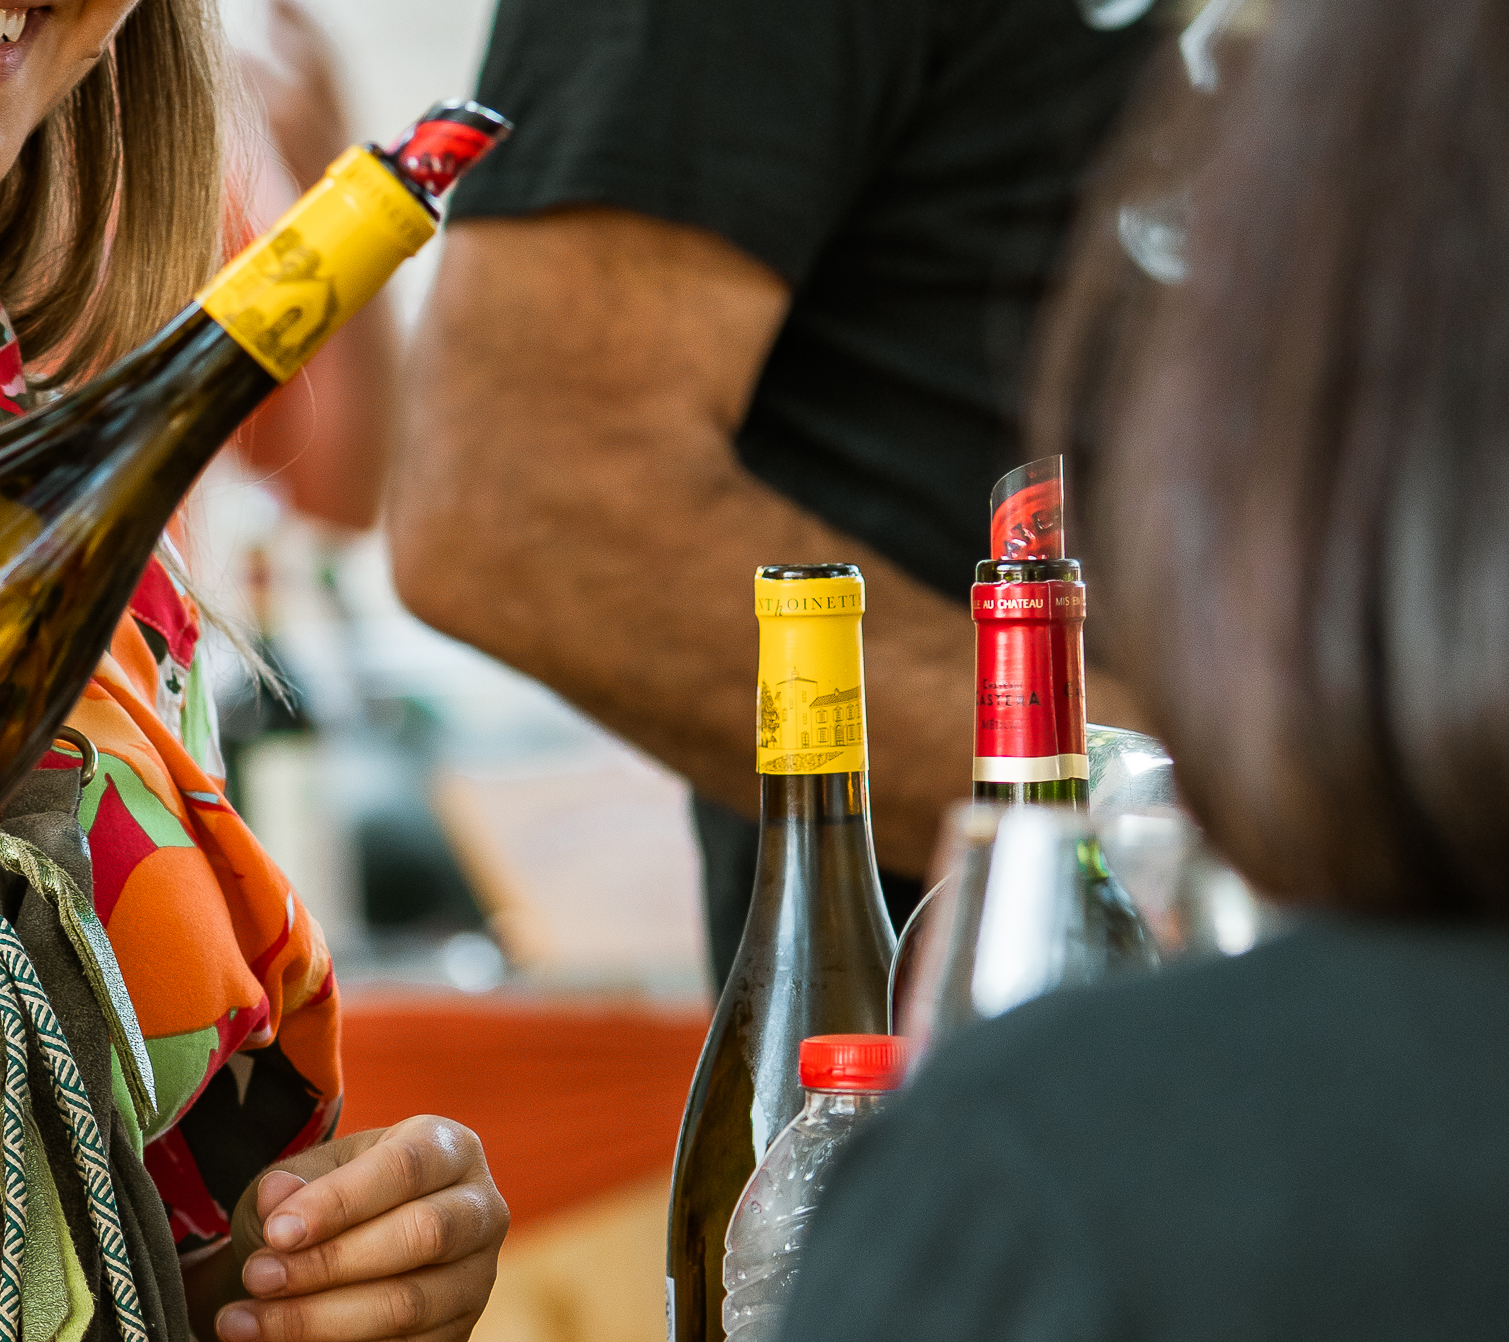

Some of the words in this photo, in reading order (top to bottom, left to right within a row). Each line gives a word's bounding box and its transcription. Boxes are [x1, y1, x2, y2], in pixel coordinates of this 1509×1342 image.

[982, 599, 994, 610] AU
[997, 598, 1044, 610] CHATEAU
[1055, 596, 1070, 607] MIS
